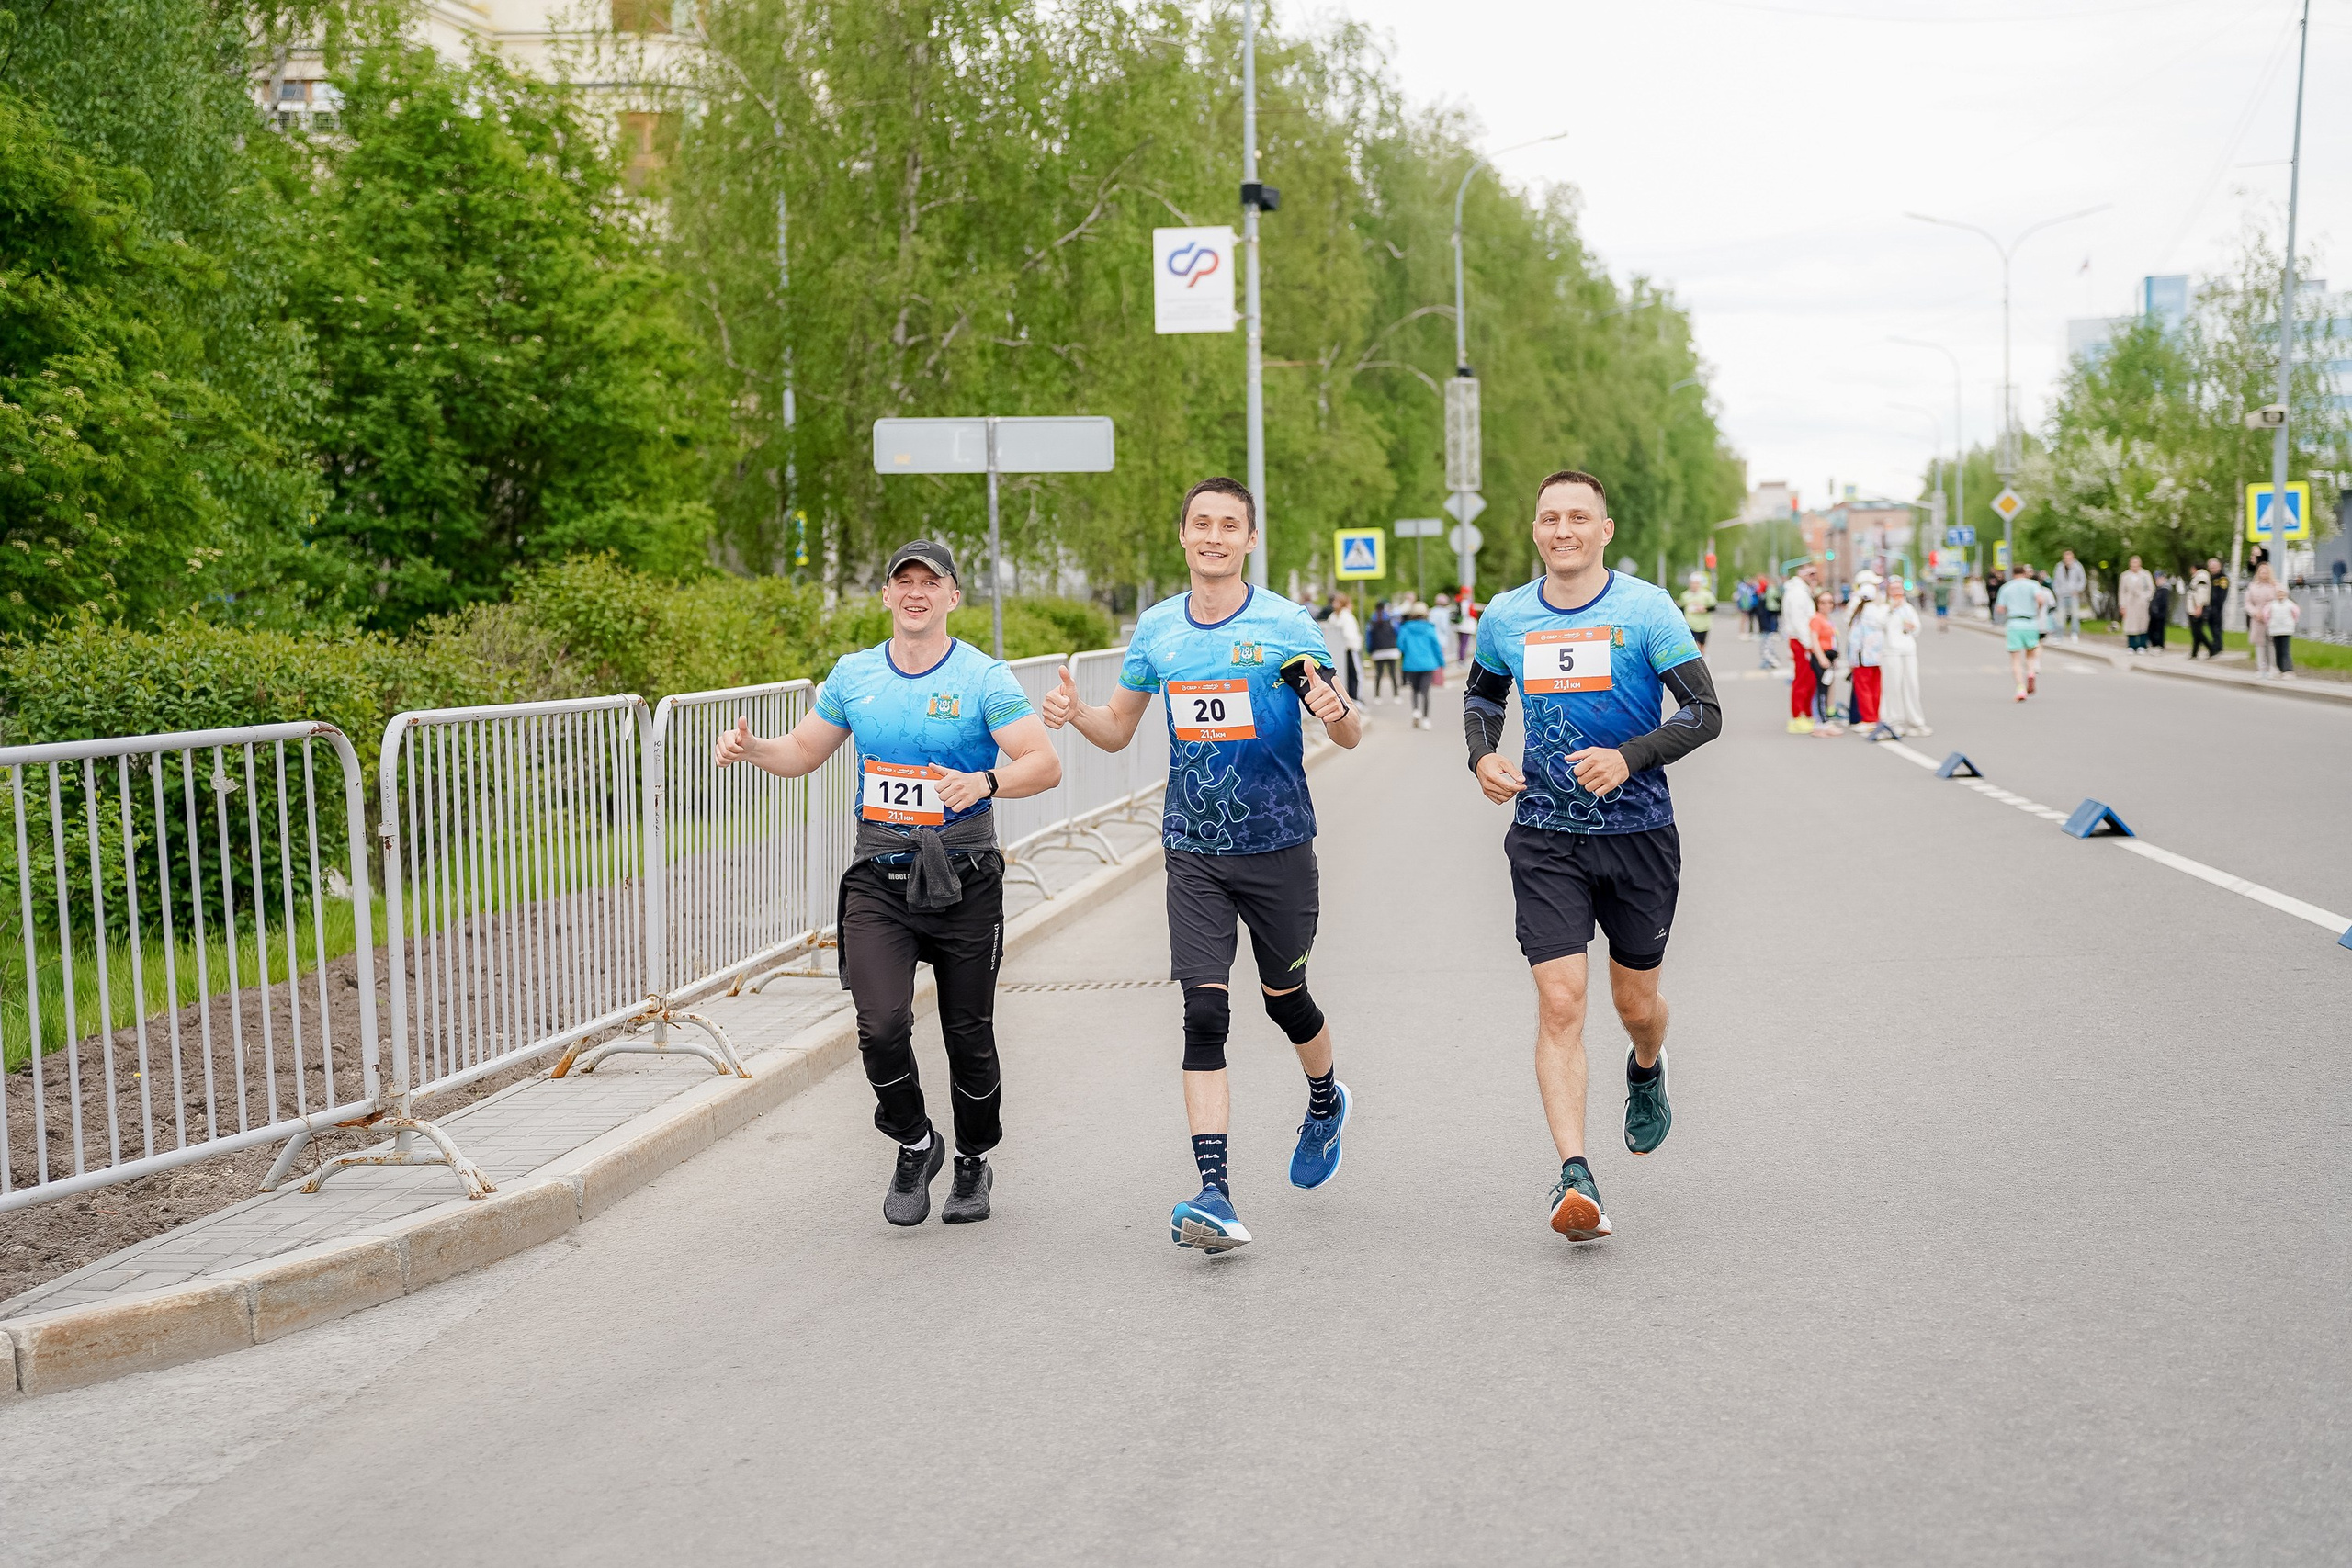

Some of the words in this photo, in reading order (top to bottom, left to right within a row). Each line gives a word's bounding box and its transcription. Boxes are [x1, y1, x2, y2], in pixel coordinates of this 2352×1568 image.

[1559, 648, 1574, 671] 5
[1193, 698, 1226, 723] 20
[879, 780, 922, 807] 121
